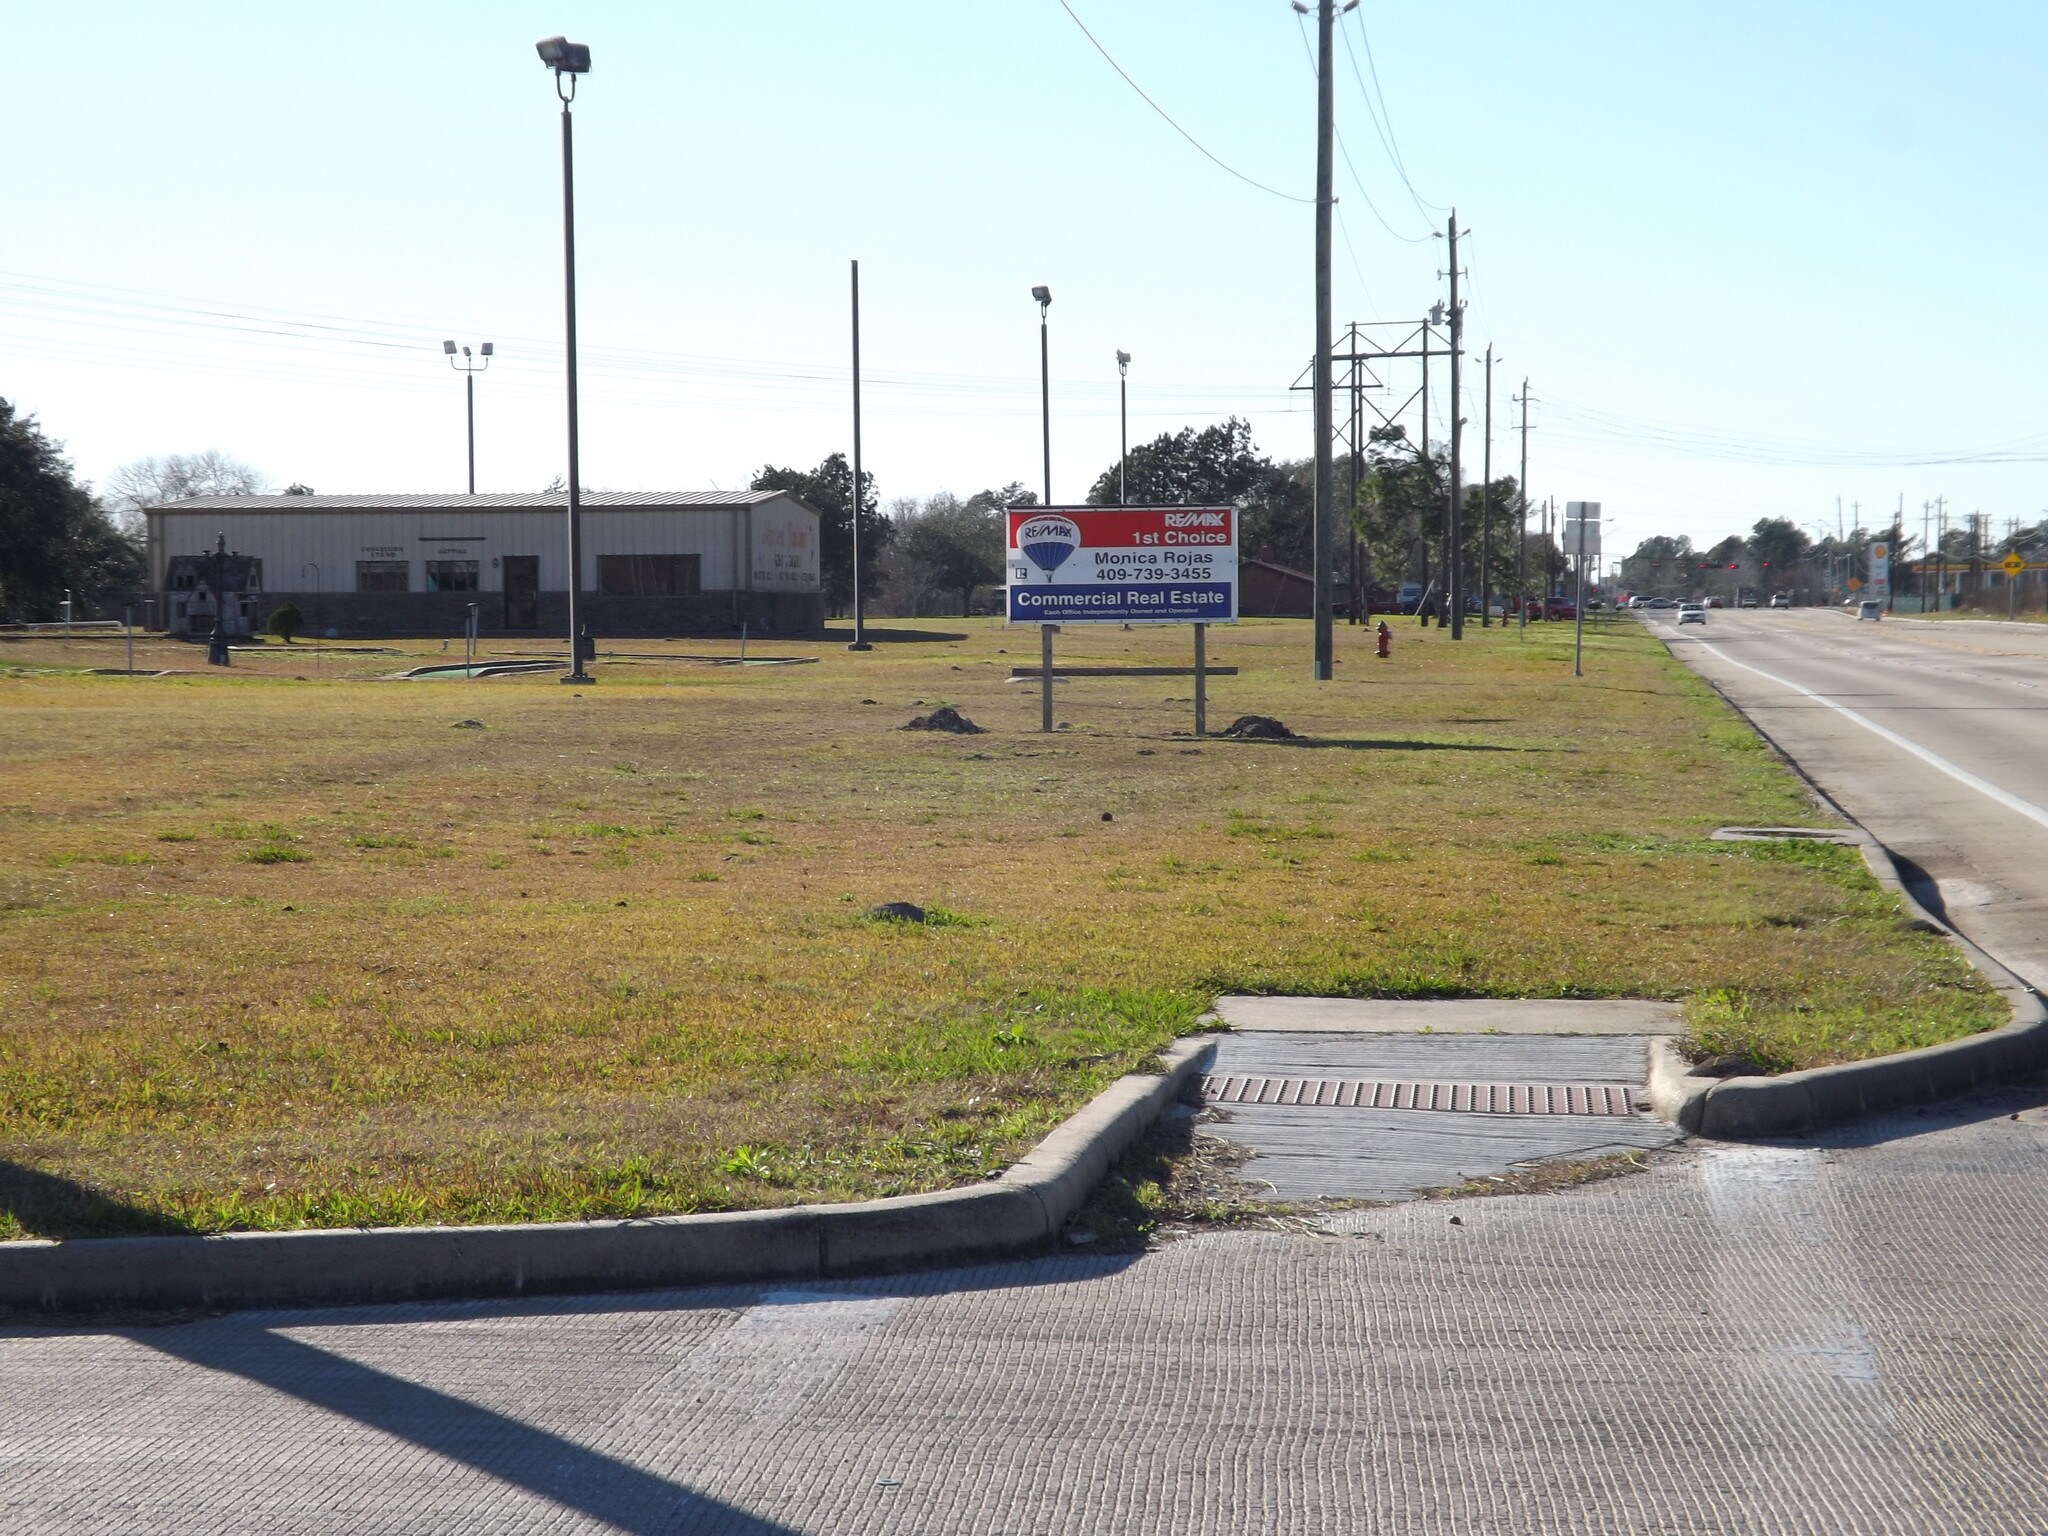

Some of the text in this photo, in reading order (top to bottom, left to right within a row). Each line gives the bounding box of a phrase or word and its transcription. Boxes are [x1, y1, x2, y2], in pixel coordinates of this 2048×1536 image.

[1165, 512, 1224, 527] RE/MAX
[1025, 524, 1072, 539] RE/MAX
[1133, 531, 1227, 544] 1st Choice
[1095, 551, 1213, 566] Monica Rojas
[1096, 567, 1211, 580] 409-739-3455
[1017, 590, 1225, 606] Commercial Real Estate
